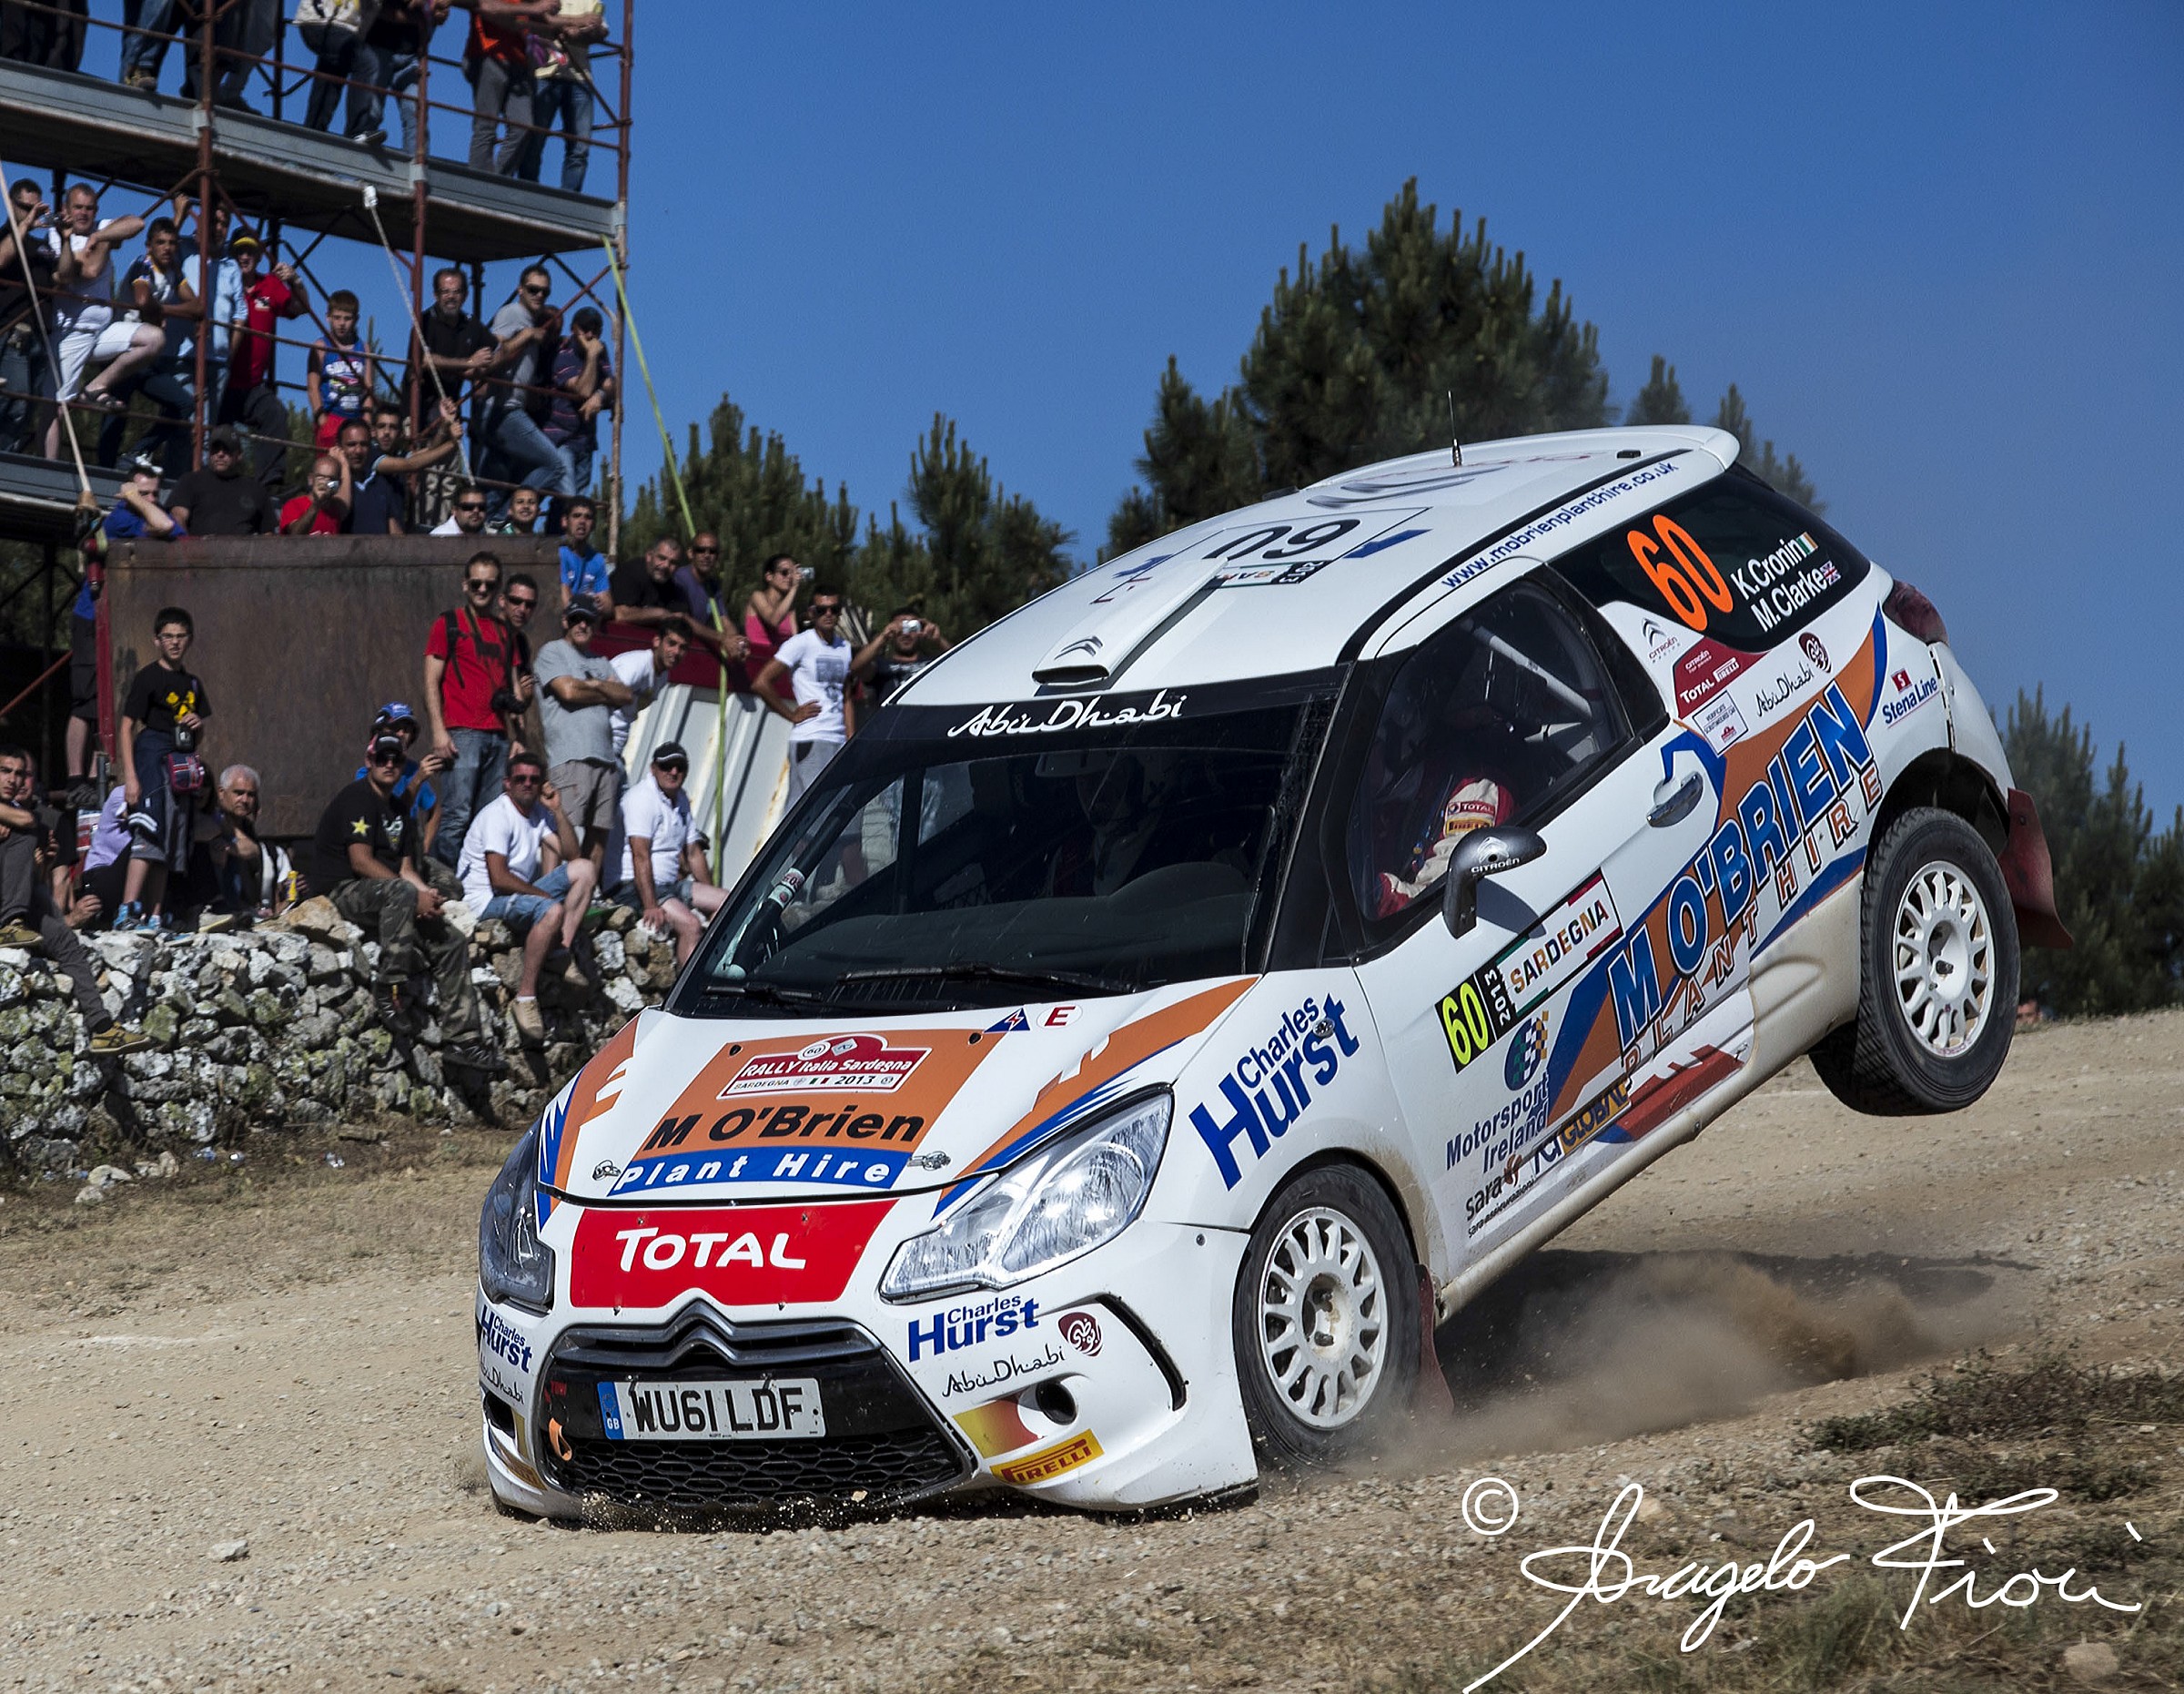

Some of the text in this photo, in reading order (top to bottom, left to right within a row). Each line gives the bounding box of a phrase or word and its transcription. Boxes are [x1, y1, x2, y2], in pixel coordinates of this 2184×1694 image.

[1442, 461, 1679, 589] www.mobrienplanthire.co.uk
[1627, 514, 1733, 632] 60
[1731, 538, 1808, 601] K.Cronin
[1751, 567, 1828, 633] M.Clarke
[1679, 656, 1740, 704] TOTAL PIRELLI
[1462, 803, 1494, 814] TOTAL
[1608, 681, 1875, 1050] M O'BRIEN
[1510, 898, 1610, 995] SARDEGNA
[1623, 760, 1883, 1078] PLANT HIRE
[1045, 1007, 1076, 1027] E
[1441, 981, 1489, 1067] 60
[1484, 968, 1511, 1027] 2013
[741, 1059, 913, 1078] RALLY Italia Sardegna
[1237, 998, 1320, 1089] Charles
[733, 1075, 875, 1090] SARDEGNA 2013
[1188, 993, 1360, 1192] Hurst
[643, 1104, 925, 1151] M O'Brien
[1447, 1071, 1549, 1171] Motorsport
[1483, 1102, 1548, 1173] Ireland
[613, 1152, 891, 1192] Plant Hire
[1466, 1175, 1503, 1221] sara
[615, 1226, 807, 1273] TOTAL
[480, 1304, 532, 1374] Hurst
[493, 1315, 525, 1345] Charles
[908, 1298, 1040, 1362] Hurst
[947, 1295, 1021, 1324] Charles
[606, 1417, 621, 1430] GB
[631, 1386, 803, 1433] WU61 LDF
[1002, 1438, 1092, 1483] PIRELLI
